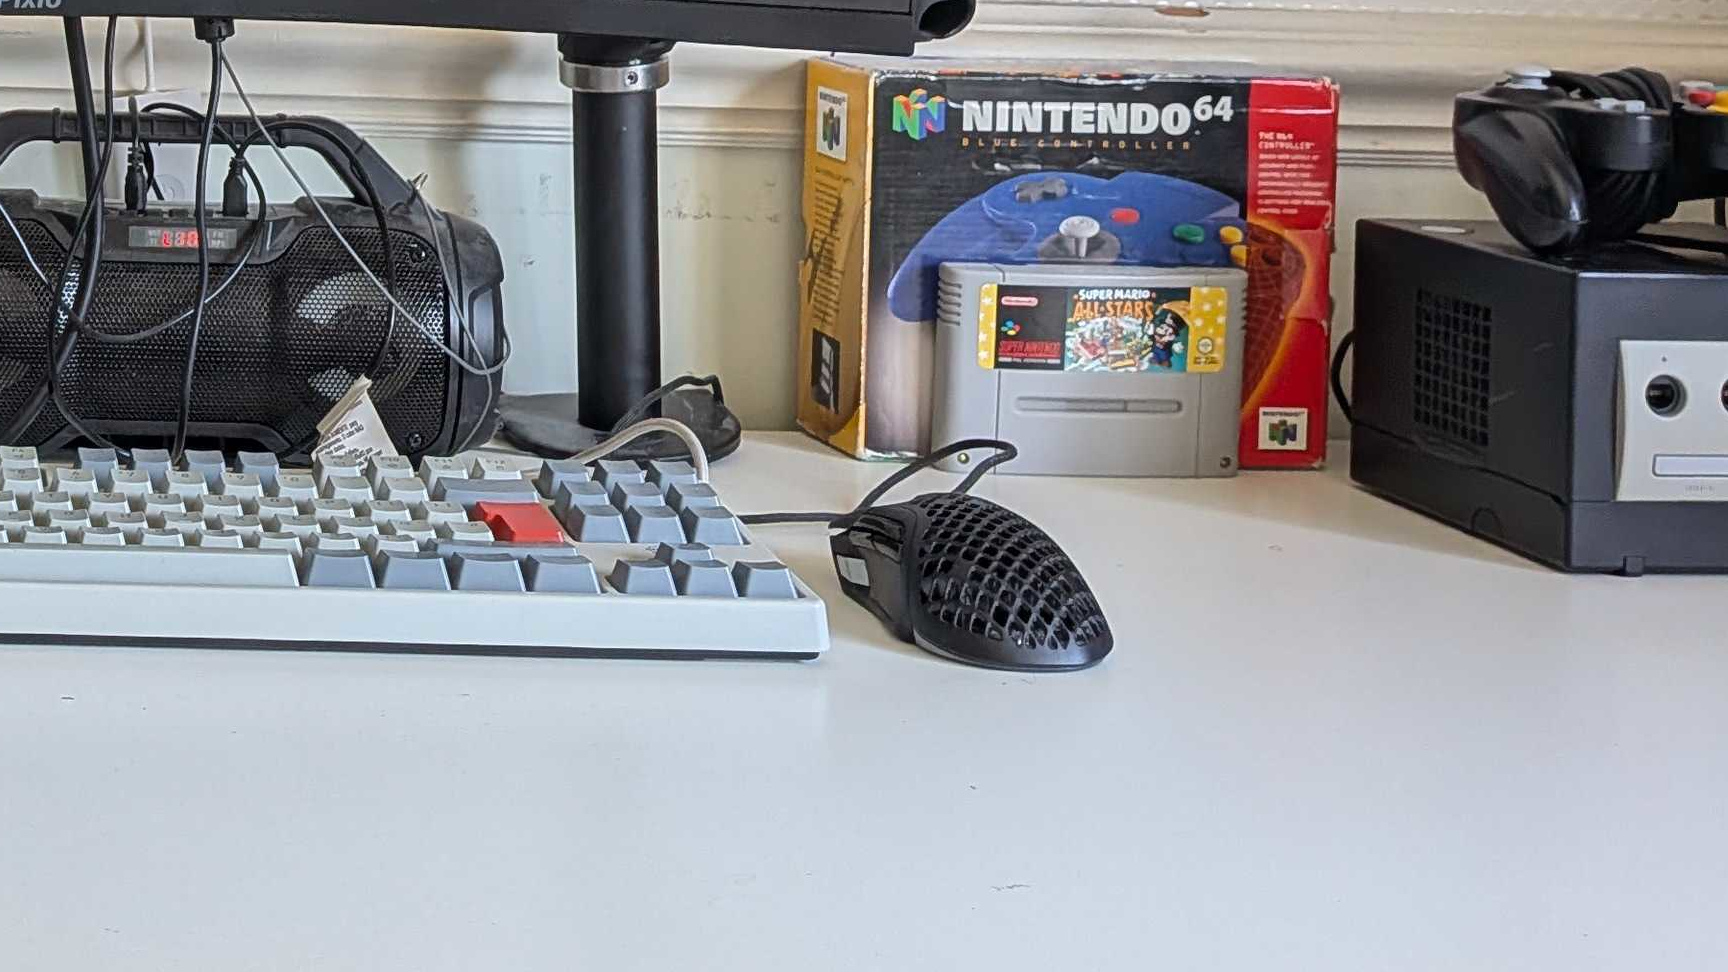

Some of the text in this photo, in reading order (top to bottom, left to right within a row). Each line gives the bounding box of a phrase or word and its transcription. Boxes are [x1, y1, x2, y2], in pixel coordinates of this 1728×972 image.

[962, 95, 1234, 135] NINTENDO 64
[1078, 288, 1151, 300] SUPER MARIO
